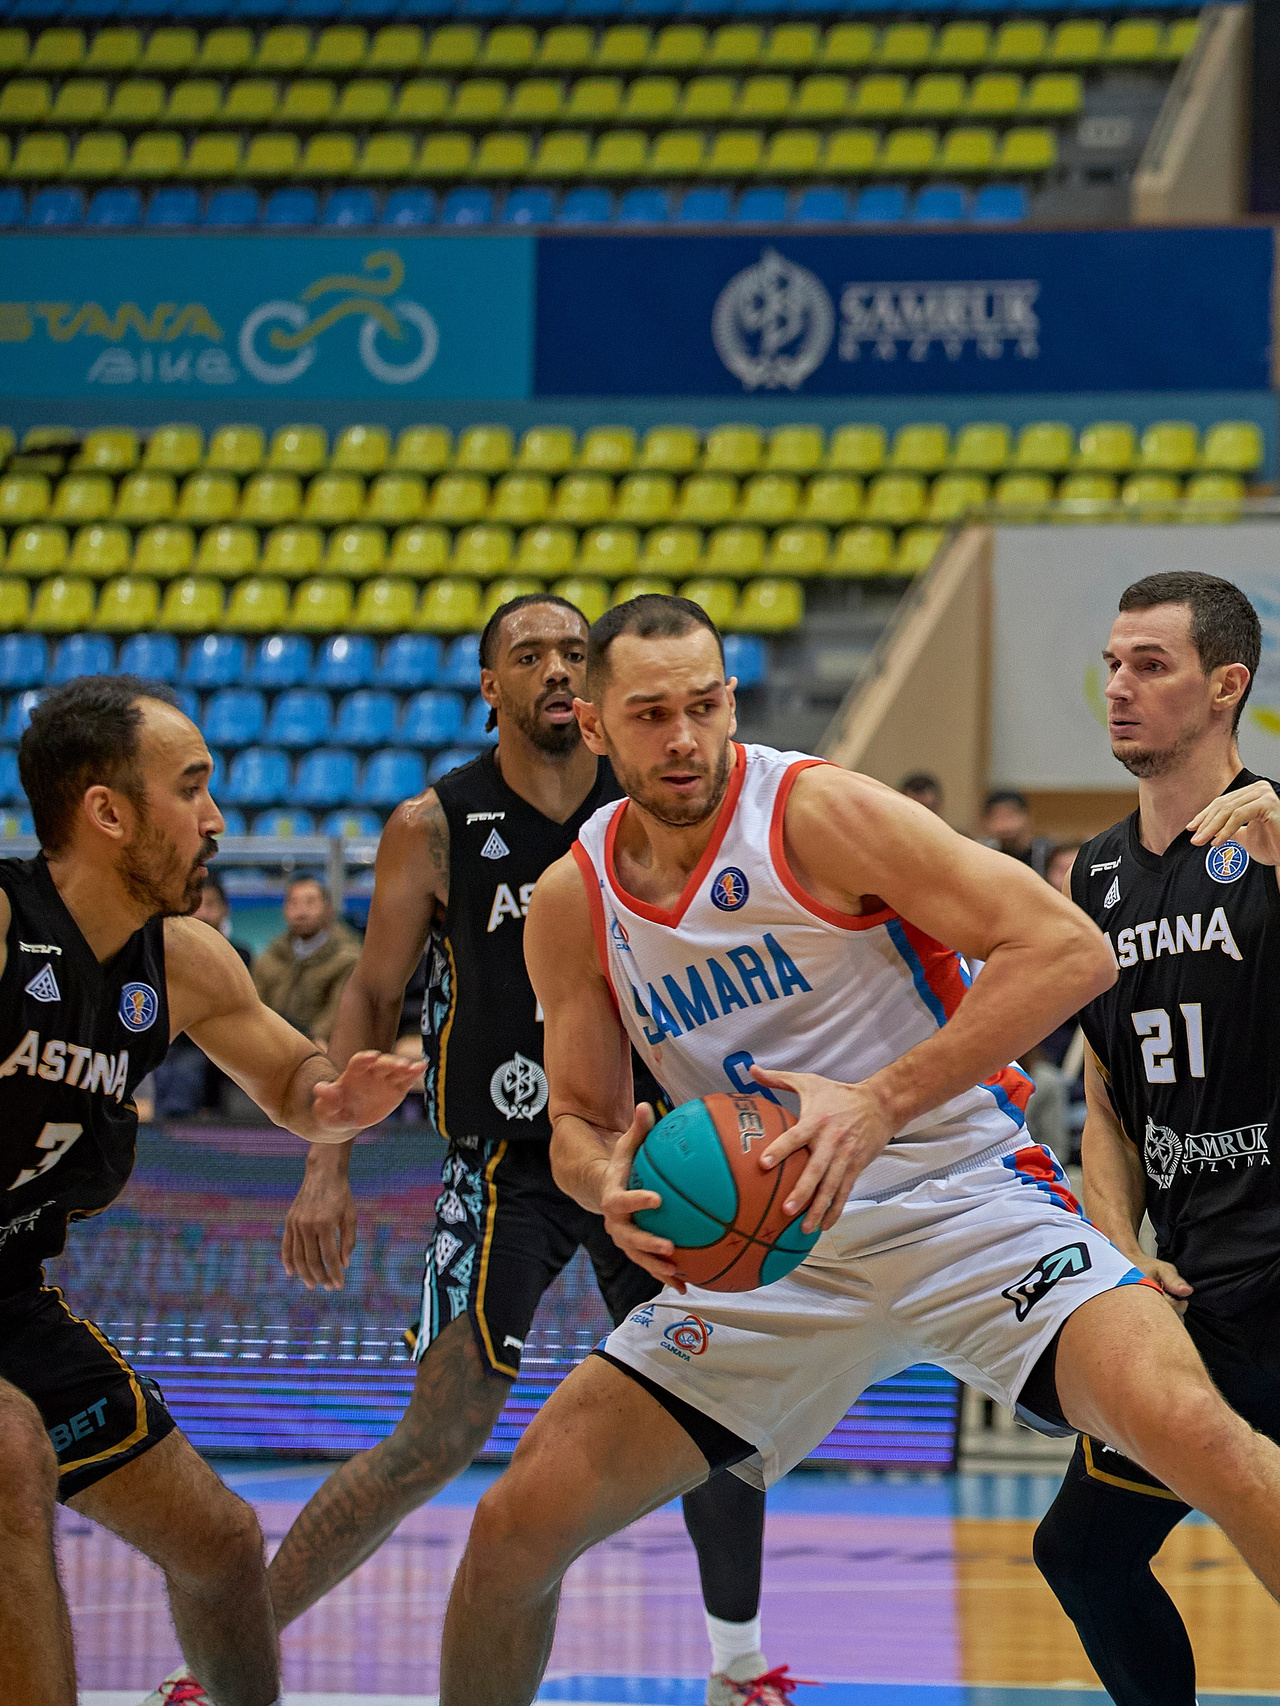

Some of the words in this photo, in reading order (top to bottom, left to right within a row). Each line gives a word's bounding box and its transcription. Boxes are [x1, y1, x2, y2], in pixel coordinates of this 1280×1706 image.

[0, 301, 224, 341] STANA
[632, 932, 813, 1046] SAMARA
[1131, 1003, 1206, 1084] 21
[1183, 1127, 1269, 1160] SAMRUK
[48, 1397, 108, 1453] BET
